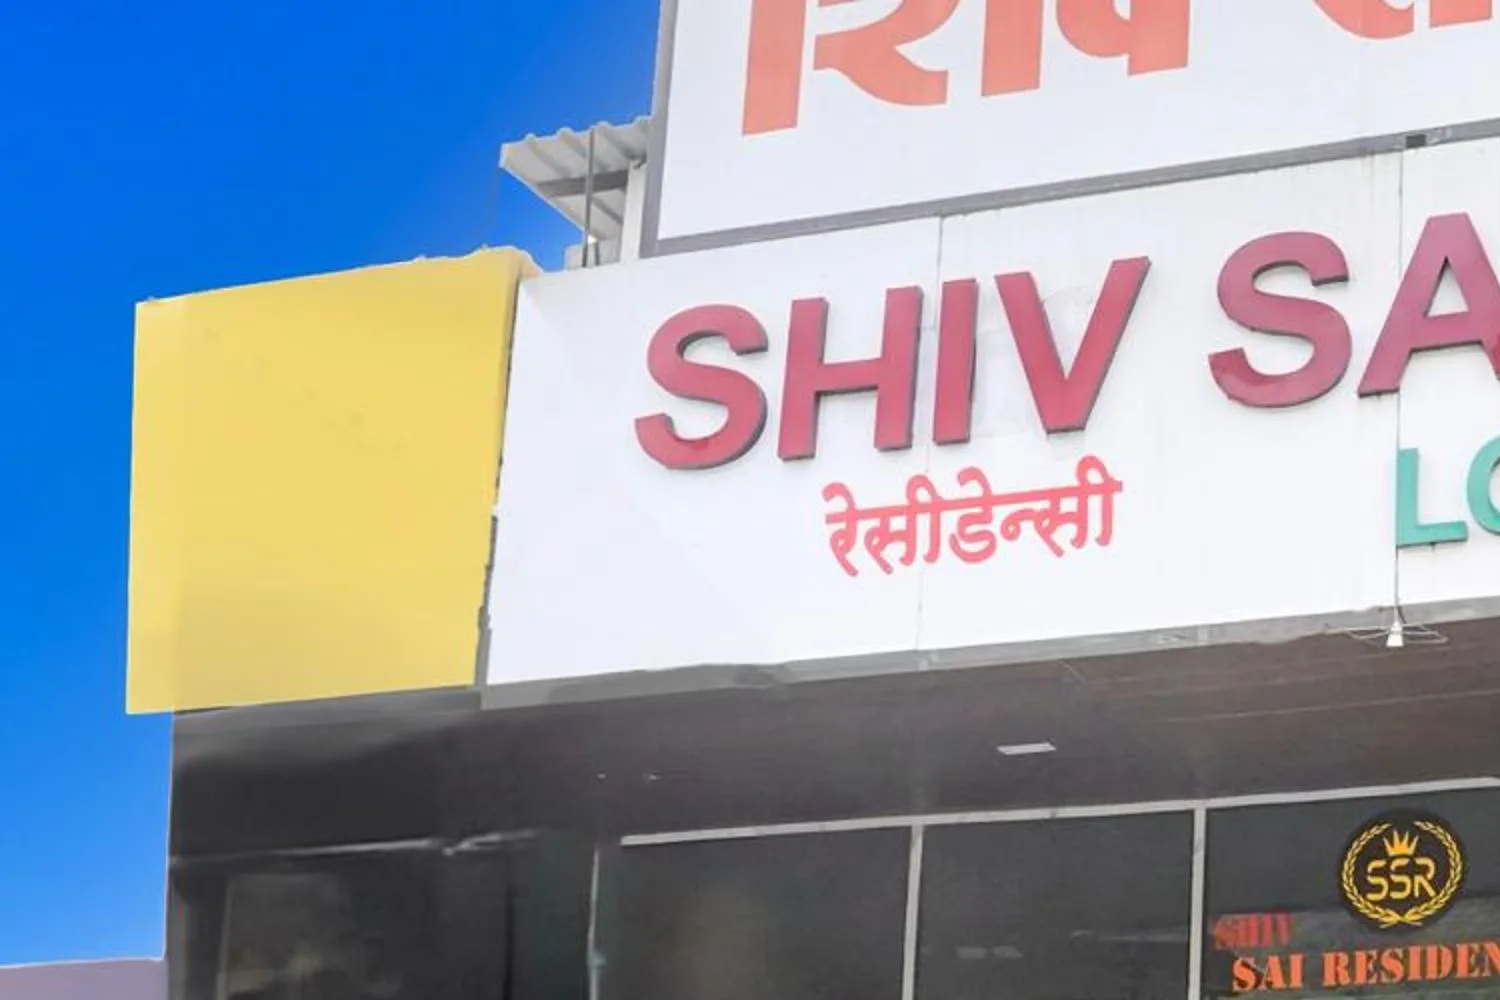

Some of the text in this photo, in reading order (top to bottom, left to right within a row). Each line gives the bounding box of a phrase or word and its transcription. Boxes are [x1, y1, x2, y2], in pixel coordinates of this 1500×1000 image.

[634, 255, 1152, 471] SHIV
[822, 455, 1123, 577] रेसीडेन्सी
[1366, 857, 1436, 901] SSR
[1232, 952, 1308, 993] SAI
